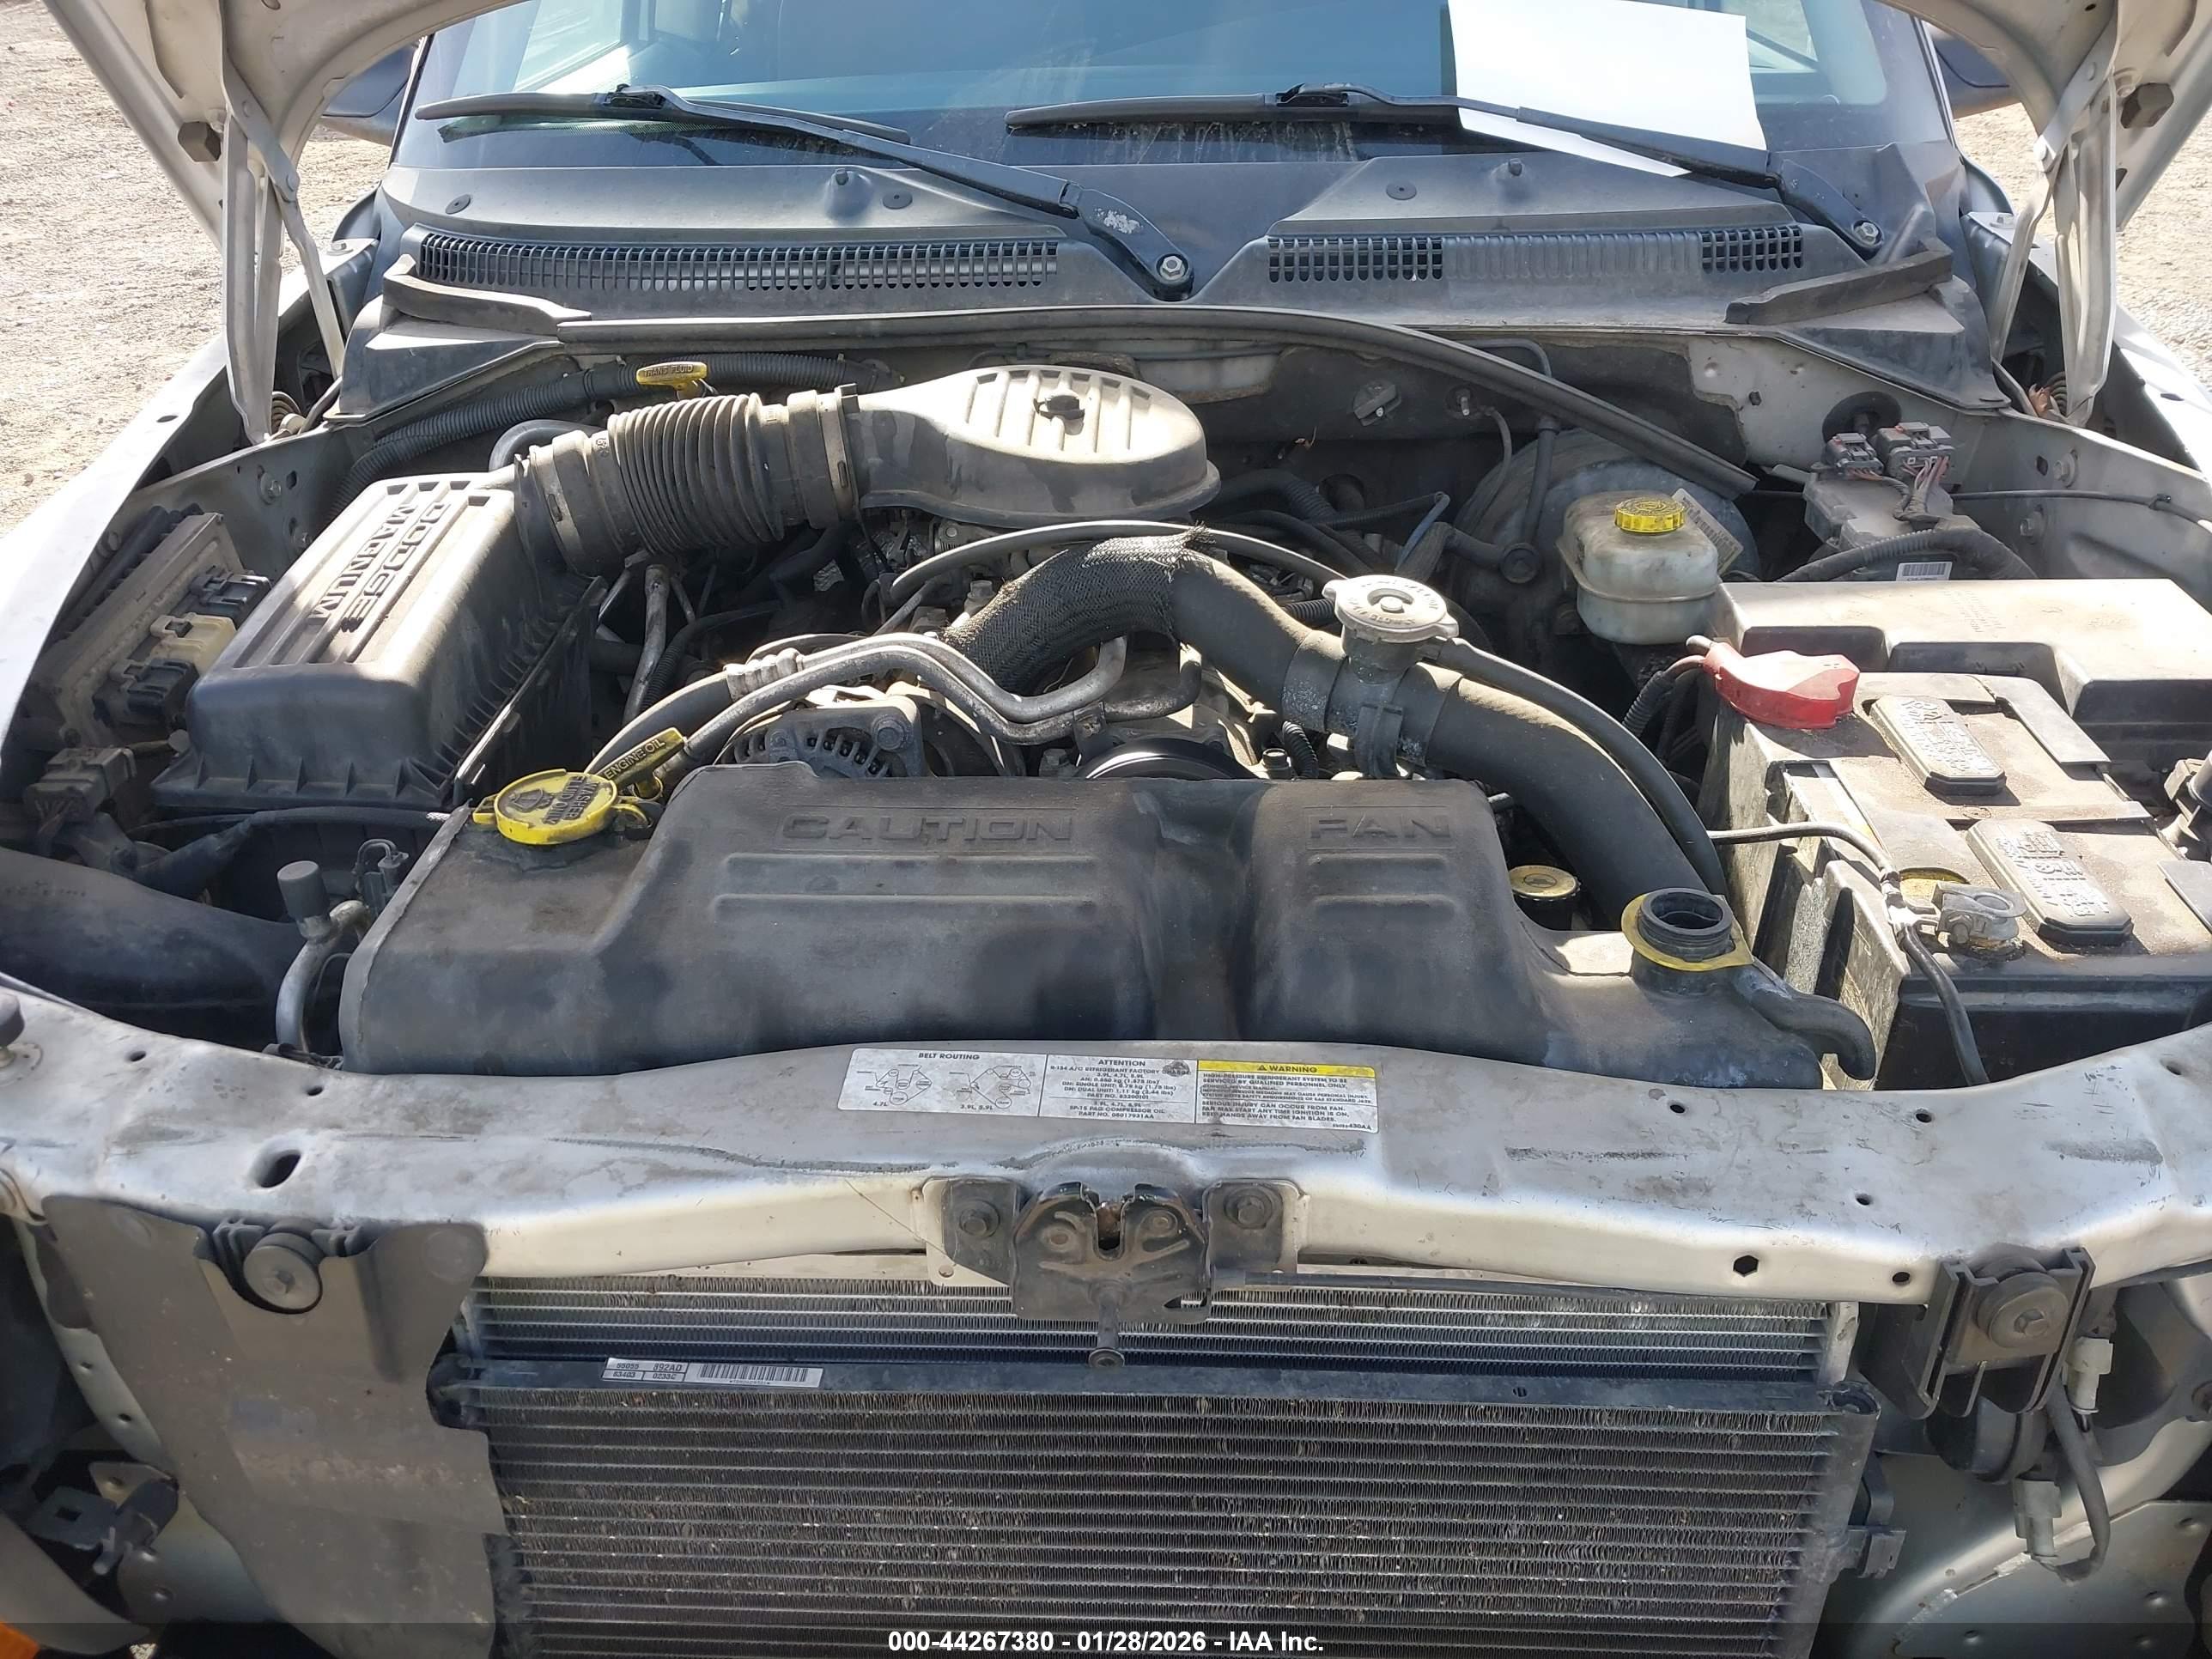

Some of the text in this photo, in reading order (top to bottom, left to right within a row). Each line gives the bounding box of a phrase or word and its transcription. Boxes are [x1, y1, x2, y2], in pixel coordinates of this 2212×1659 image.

[645, 364, 693, 376] TRANS FLUID
[307, 503, 418, 622] MAGNUM
[340, 501, 451, 633] DODGE
[604, 738, 665, 780] ENGINE OIL
[562, 775, 588, 799] FLUID
[568, 781, 599, 818] WASHER
[782, 815, 1450, 842] CAUTION FAN
